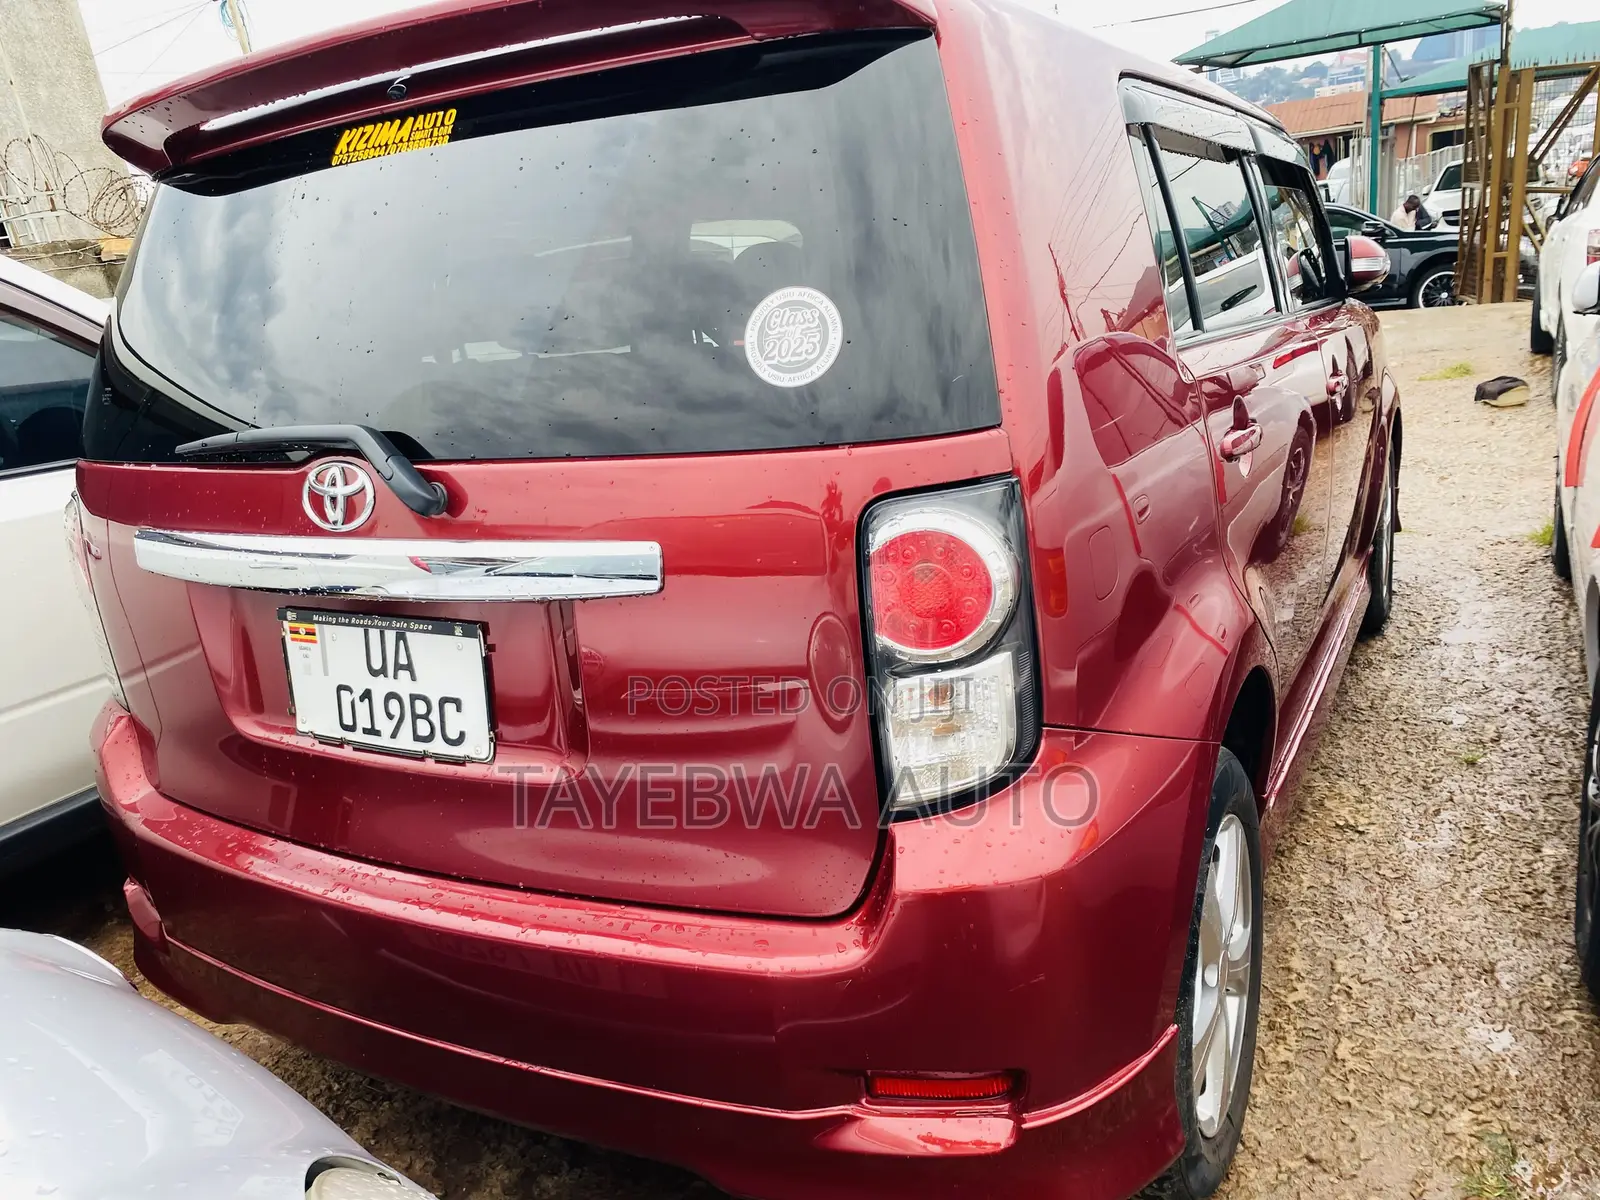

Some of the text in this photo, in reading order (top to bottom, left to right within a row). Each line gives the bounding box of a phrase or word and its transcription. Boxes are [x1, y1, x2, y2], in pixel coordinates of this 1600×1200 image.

[335, 108, 457, 155] KIZIMA AUTO
[410, 128, 433, 141] SMART
[750, 299, 774, 331] PROUDLY
[823, 305, 838, 334] ALUMNI
[766, 308, 818, 332] Class
[763, 334, 819, 361] 2025
[785, 325, 801, 342] of
[816, 343, 836, 372] ALUMNI
[313, 614, 336, 624] Making
[338, 616, 350, 624] the
[391, 620, 408, 629] Safe
[409, 621, 433, 631] Space
[363, 628, 417, 682] UA
[335, 683, 466, 747] 019BC
